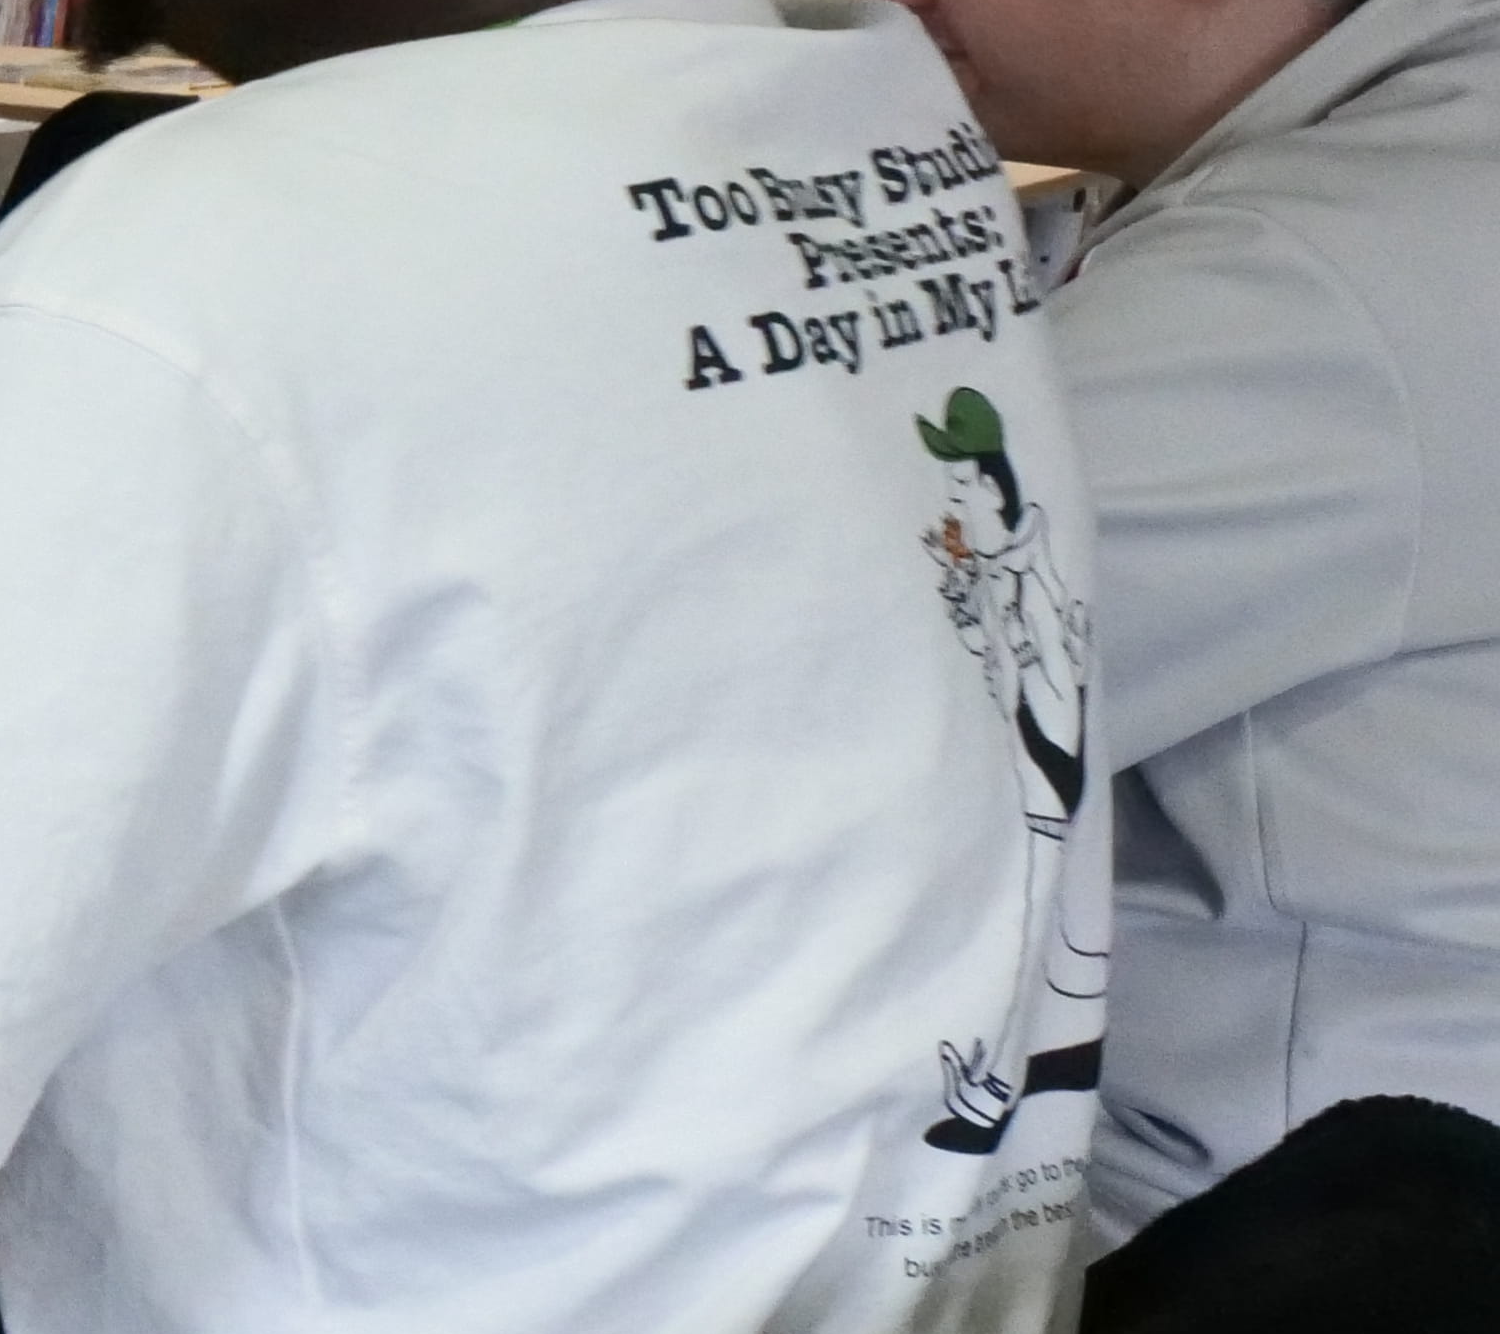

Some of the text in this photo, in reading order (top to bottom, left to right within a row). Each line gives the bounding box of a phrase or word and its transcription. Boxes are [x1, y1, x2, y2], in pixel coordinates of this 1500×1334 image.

[627, 176, 760, 242] Too
[745, 166, 866, 229] Busy
[785, 204, 1005, 290] Presents:
[684, 323, 744, 391] A
[748, 307, 861, 376] Day
[862, 286, 924, 350] in
[915, 271, 996, 344] My
[864, 1215, 913, 1239] This
[920, 1211, 943, 1236] is
